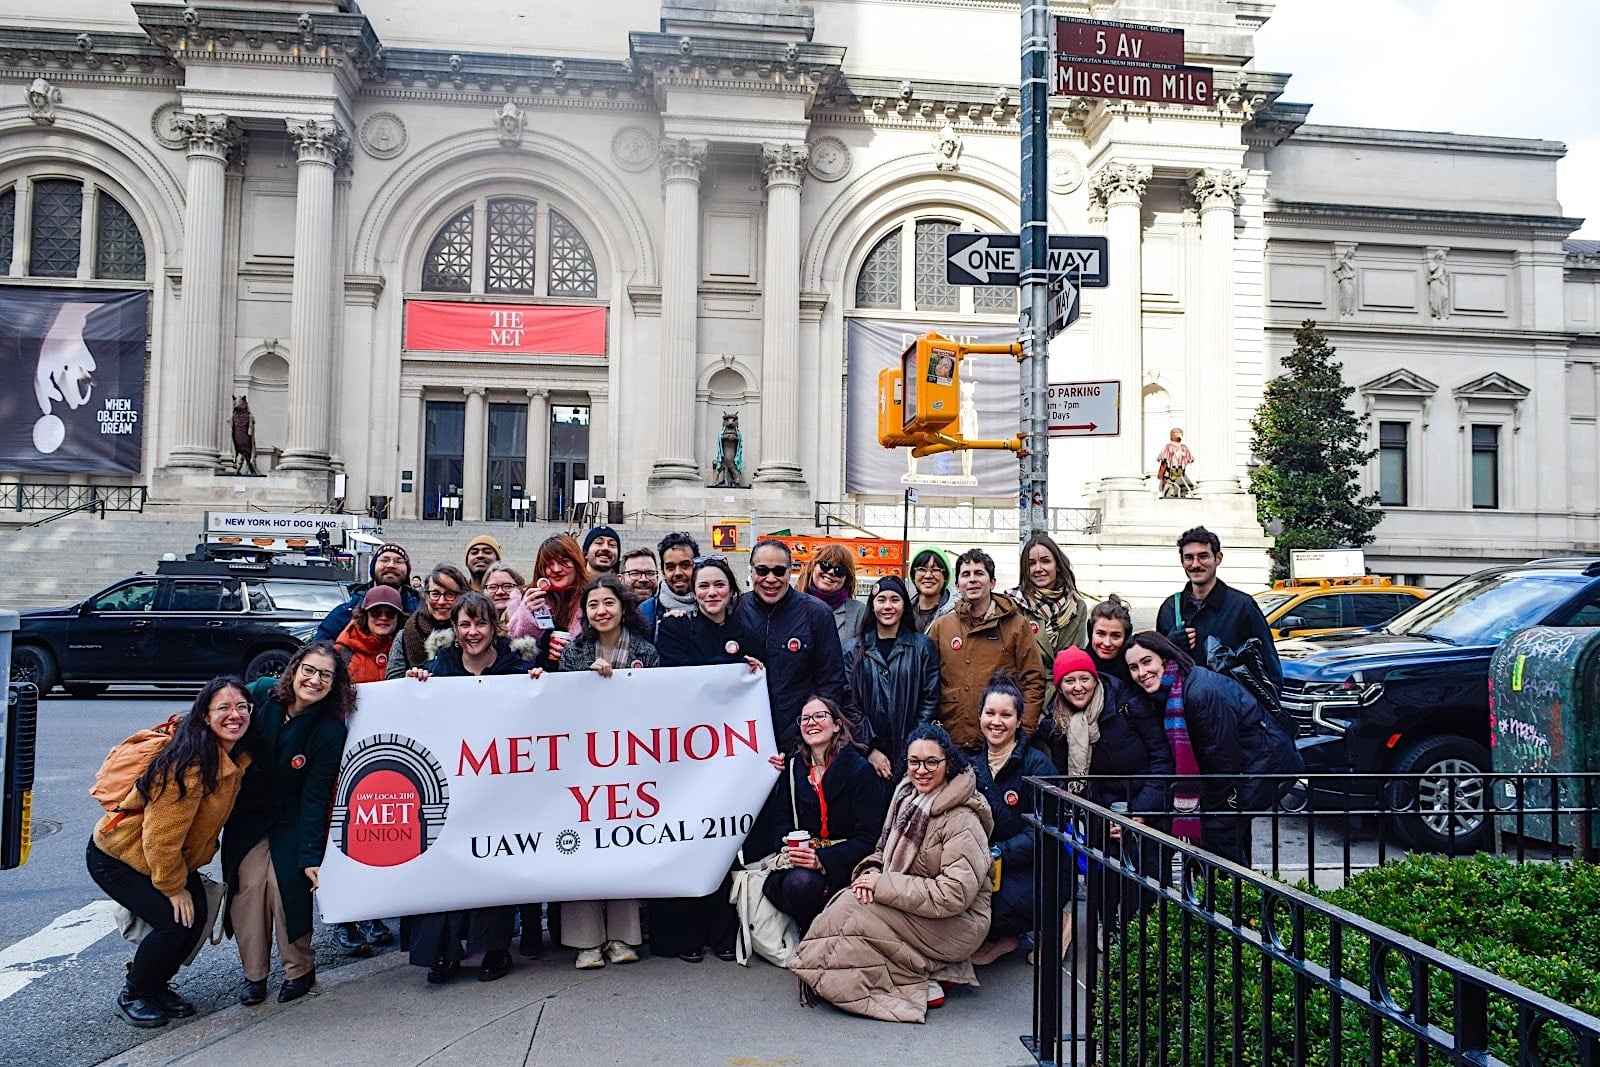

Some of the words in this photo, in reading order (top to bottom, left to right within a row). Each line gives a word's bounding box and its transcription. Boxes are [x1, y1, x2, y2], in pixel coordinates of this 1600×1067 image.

[1060, 16, 1100, 25] METROPOLITAN
[1096, 30, 1106, 55] 5
[1116, 33, 1142, 58] Av
[1059, 66, 1150, 96] Museum
[1162, 73, 1207, 100] Mile
[968, 250, 1015, 270] ONE
[1050, 252, 1094, 272] WAY
[1056, 288, 1070, 317] WAY
[490, 310, 524, 328] THE
[489, 329, 524, 346] MET
[1048, 388, 1054, 398] O
[1058, 386, 1100, 398] PARKING
[104, 398, 131, 410] WHEN
[1064, 400, 1080, 410] 7pm
[97, 410, 138, 422] OBJECTS
[1052, 412, 1070, 420] Days
[101, 422, 132, 434] DREAM
[248, 519, 271, 527] YORK
[274, 520, 290, 528] HOT
[294, 520, 312, 528] DOG
[455, 733, 570, 777] MET
[586, 720, 759, 768] UNION
[567, 780, 661, 823] YES
[354, 802, 414, 826] MET
[356, 828, 412, 842] UNION
[470, 832, 542, 859] UAW
[595, 820, 694, 849] LOCAL
[702, 814, 754, 840] 2110
